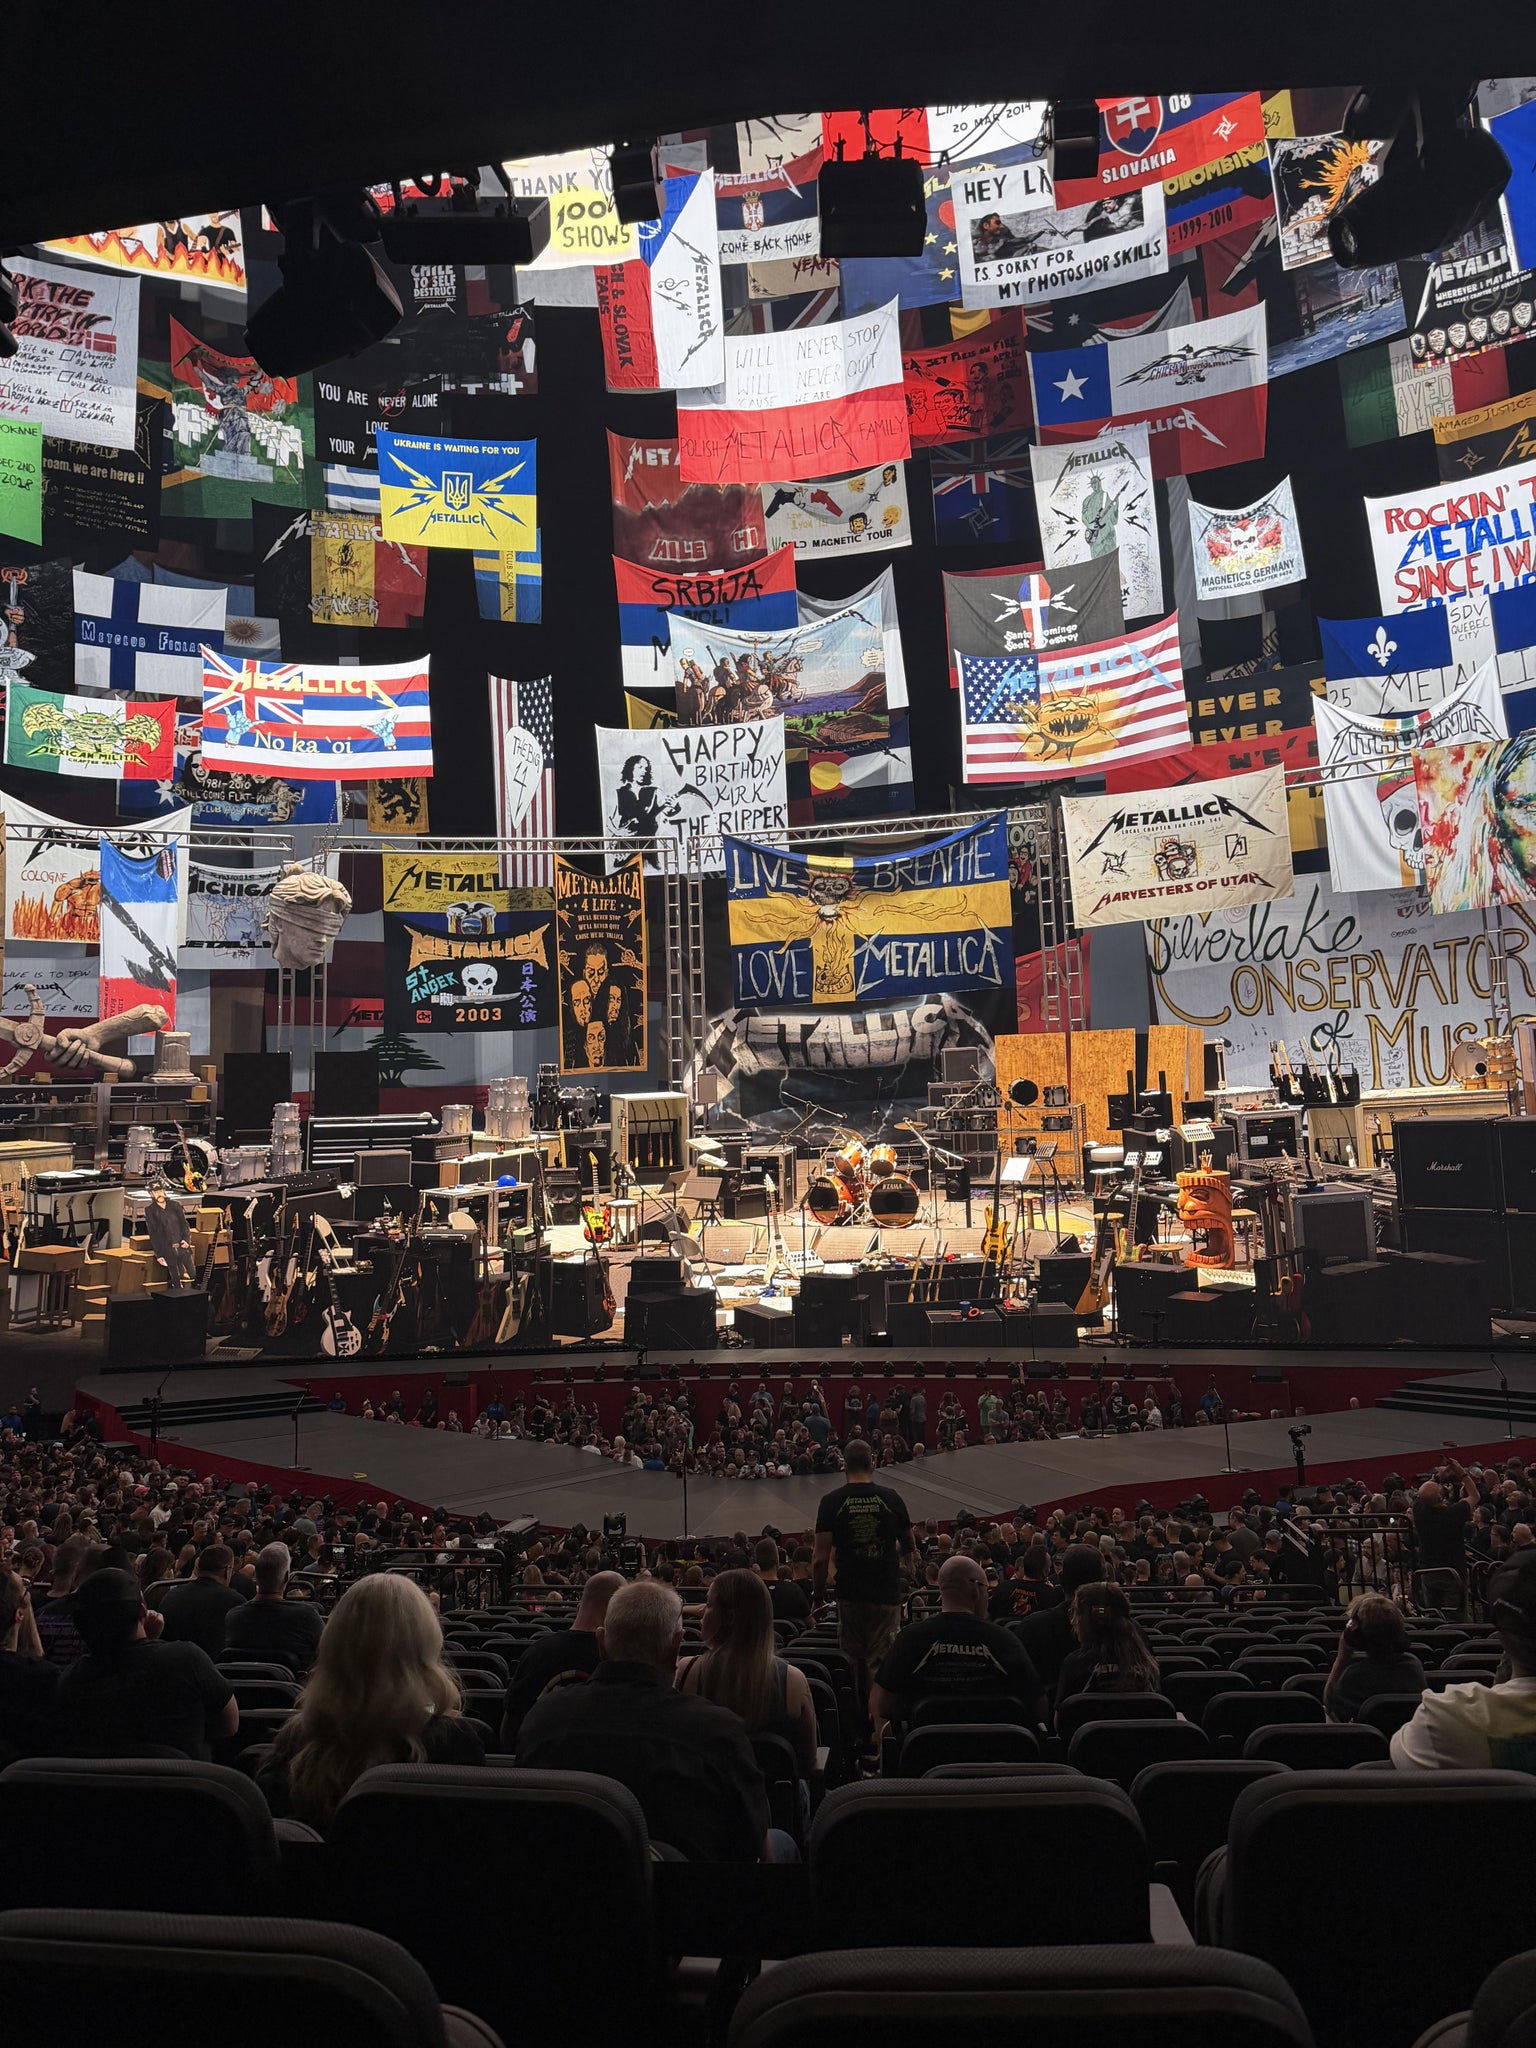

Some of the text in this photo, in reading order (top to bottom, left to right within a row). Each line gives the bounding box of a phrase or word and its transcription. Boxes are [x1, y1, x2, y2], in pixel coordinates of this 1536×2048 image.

[953, 122, 968, 133] 20
[1006, 103, 1031, 118] 2014
[1102, 148, 1176, 184] SLOVAKIA
[1163, 148, 1255, 196] OLOMBIA
[511, 172, 577, 195] THANK
[964, 175, 1007, 204] HEY
[1023, 166, 1053, 195] LA
[563, 223, 631, 247] SHOWS
[720, 232, 812, 255] COME BACK HOME
[410, 265, 454, 278] CHILE
[996, 257, 1040, 278] SORRY
[1047, 250, 1075, 266] FOR
[998, 240, 1162, 300] MY PHOTOSHOP SKILLS
[47, 281, 95, 307] THE
[413, 275, 456, 288] TO SELF
[413, 286, 456, 297] DESTRUCT
[595, 275, 611, 315] FANS
[1414, 245, 1508, 329] METALLI
[1435, 274, 1504, 301] WHEREVER MAY
[613, 304, 634, 370] SLOVAK
[736, 324, 881, 369] WILL NEVER STOP
[736, 373, 774, 396] WILL
[796, 363, 842, 388] NEVER
[847, 352, 878, 378] QUIT
[319, 382, 438, 408] YOU ARE NEVER ALONE
[366, 420, 389, 435] LOVE
[329, 438, 355, 454] YOUR
[393, 438, 520, 456] UKRAINE IS WAITING FOR YOU
[680, 416, 906, 480] POLISH METALLICA FAMILY
[2, 472, 34, 491] 2018
[73, 462, 89, 475] we
[90, 466, 108, 479] are
[110, 468, 135, 483] here
[1050, 440, 1147, 497] METALLICA
[419, 509, 498, 541] METALLICA
[1384, 484, 1510, 535] ROCKIN'
[770, 528, 893, 551] WOLD MAGNETIC TOUR
[1397, 502, 1536, 571] METALL
[1201, 558, 1296, 588] MAGNETICS GERMANY
[1208, 573, 1278, 593] OFFICIAL LOCAL CHAPTER
[1394, 552, 1485, 604] SINCE
[1492, 548, 1501, 583] I
[652, 568, 763, 613] SRBIJA
[1449, 600, 1488, 624] SDV
[1451, 616, 1491, 635] QUEBEC
[81, 620, 213, 654] METCLUB FINLAD
[1458, 629, 1480, 643] CITY
[223, 668, 400, 709] METALLICA
[977, 641, 1178, 725] METALLICA
[254, 729, 285, 751] No
[292, 736, 320, 753] ka
[1325, 701, 1509, 768] LITHUANIA
[99, 752, 150, 768] MILITIA
[662, 725, 764, 778] HAPPY
[695, 750, 785, 788] BIRTHDAY
[713, 782, 768, 808] KIRK
[1076, 793, 1277, 864] METALLICA
[20, 869, 68, 883] COLOGNE
[733, 848, 801, 892] LIVE
[873, 828, 996, 889] BREATHE
[188, 874, 278, 897] MICHIGA
[557, 870, 641, 900] METALLICA
[1089, 870, 1277, 916] HARVESTERS OF UTAH
[582, 900, 616, 912] 4 LIFE
[1148, 883, 1363, 975] Silverlake
[403, 922, 551, 973] METALLICA
[738, 949, 810, 1002] LOVE
[852, 912, 1004, 997] METALLICA
[34, 970, 42, 978] IS
[50, 970, 63, 978] TO
[1155, 912, 1536, 1027] CONSERVATOR
[410, 970, 461, 1004] ANGER
[519, 961, 538, 1024] 日本公演
[455, 1007, 503, 1023] 2003
[1310, 1010, 1354, 1075] of
[1427, 1161, 1463, 1171] Marshall
[912, 1640, 1008, 1675] METALLICA
